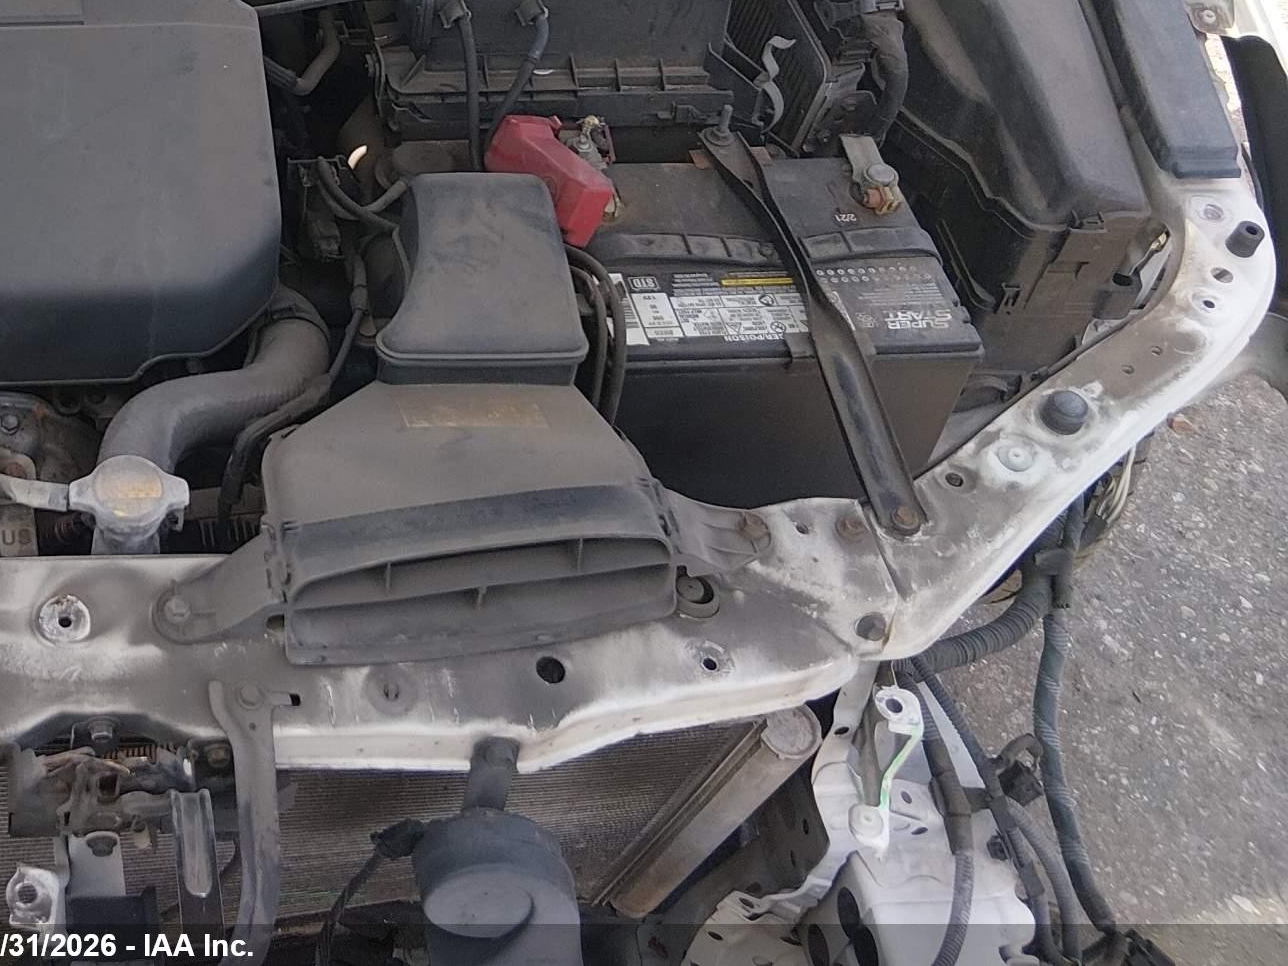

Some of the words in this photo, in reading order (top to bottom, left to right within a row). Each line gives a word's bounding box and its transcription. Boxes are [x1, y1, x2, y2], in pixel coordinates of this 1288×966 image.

[632, 278, 656, 289] STD
[884, 308, 953, 321] START
[886, 318, 950, 330] SUPER
[1, 528, 33, 546] US
